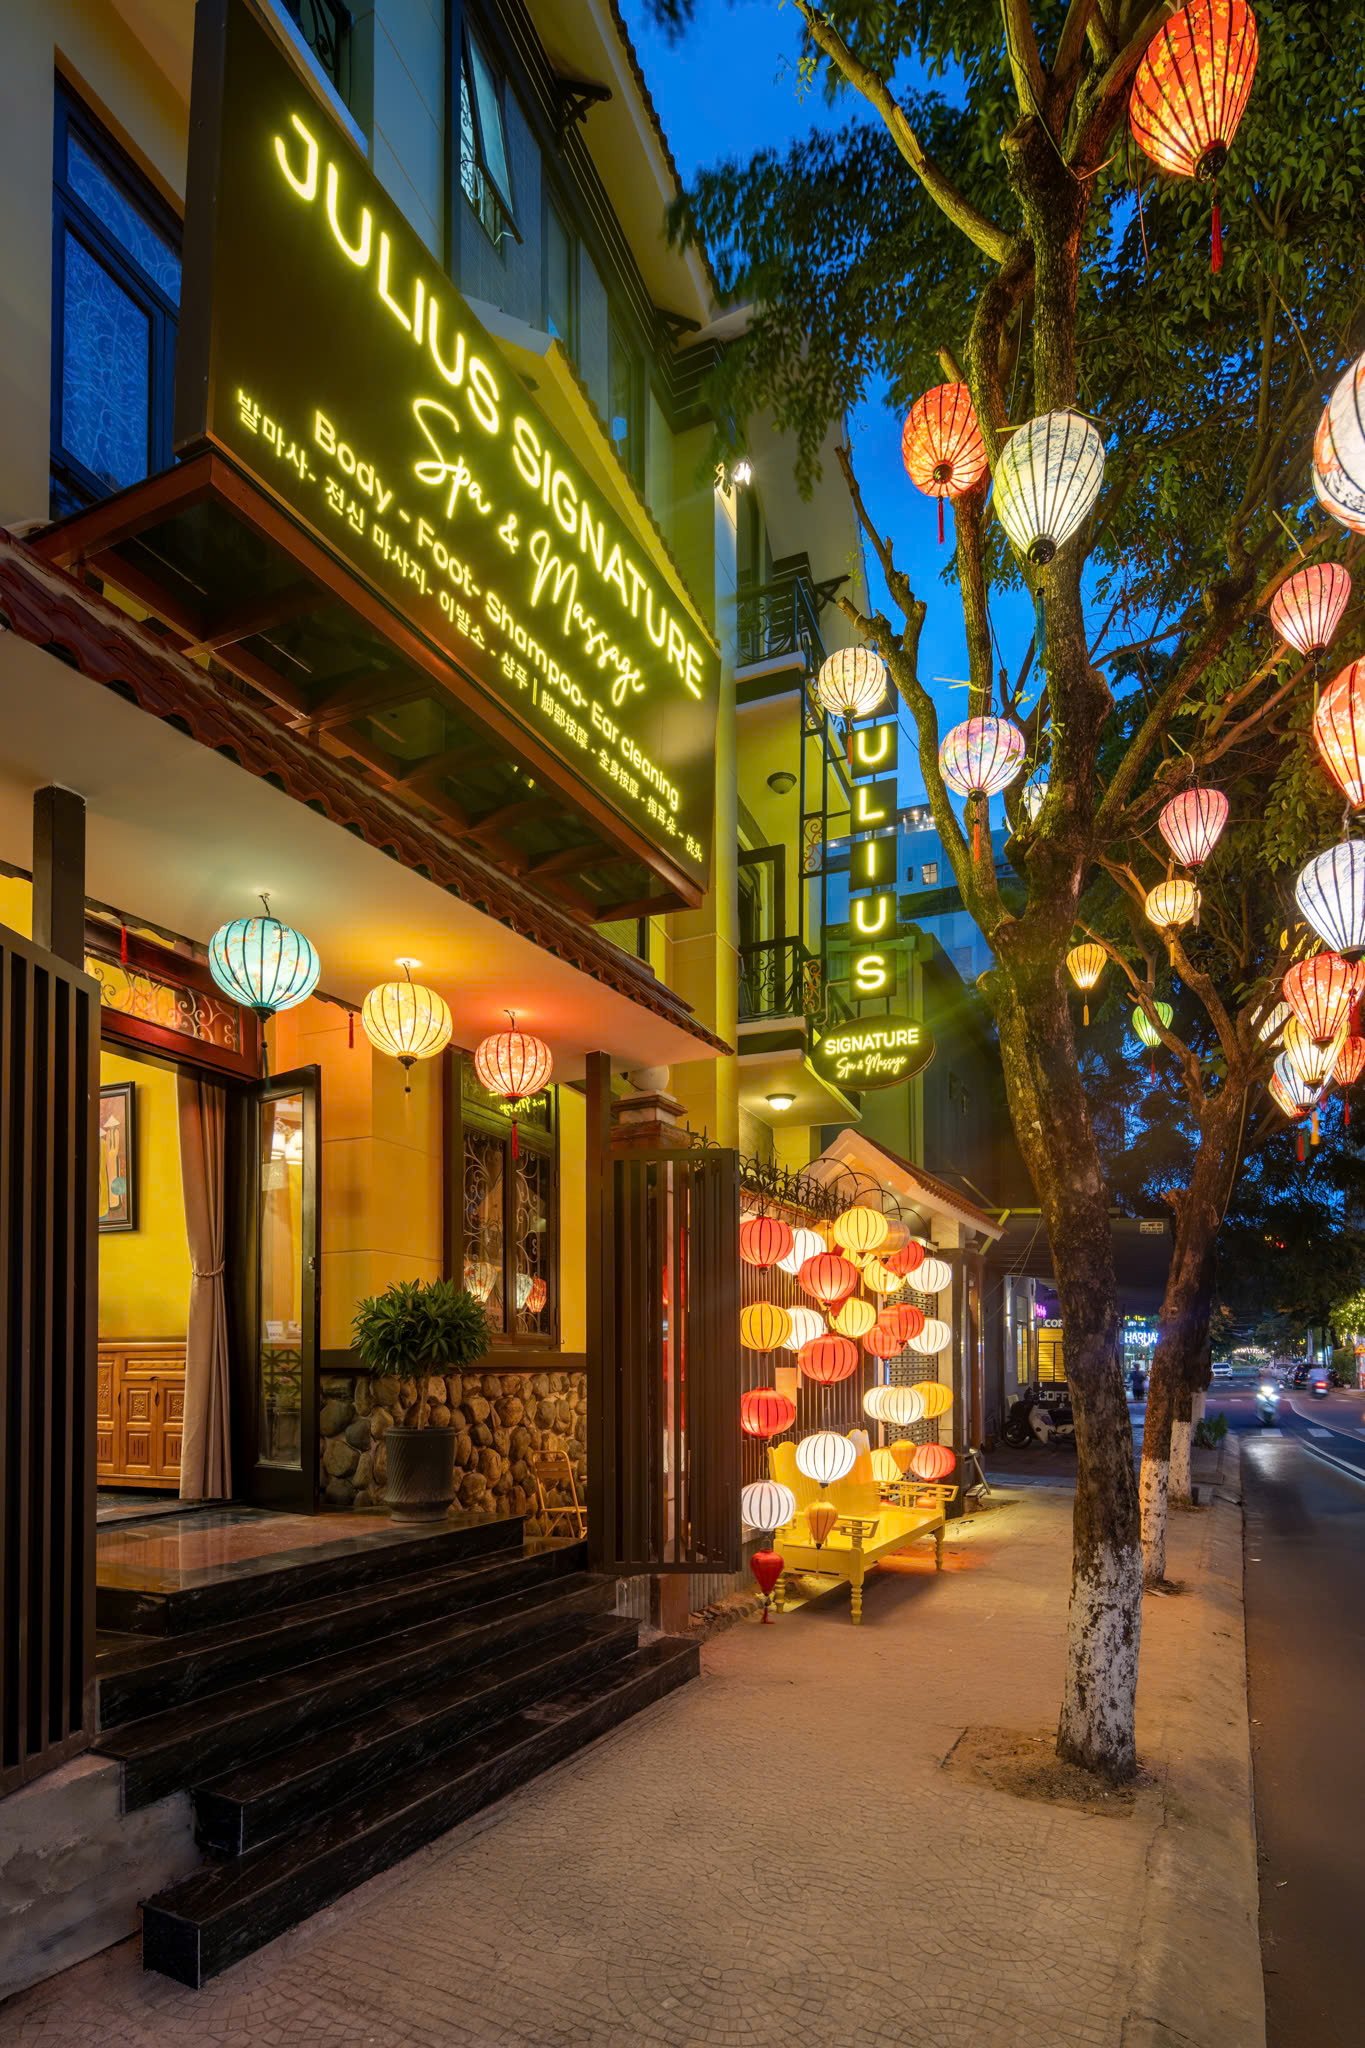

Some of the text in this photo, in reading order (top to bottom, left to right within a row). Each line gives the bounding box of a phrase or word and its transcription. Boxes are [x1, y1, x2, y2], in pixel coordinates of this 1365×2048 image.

[274, 113, 704, 700] JULIUS SIGNATURE
[413, 397, 646, 707] Spa & Massage
[314, 410, 393, 514] Body
[591, 700, 620, 745] Ear
[620, 736, 680, 813] cleaning
[325, 476, 365, 536] 전신
[439, 590, 486, 651] 이발소
[500, 651, 529, 691] 샴푸
[856, 692, 889, 991] ULIUS
[824, 1027, 920, 1056] SIGNATURE
[835, 1056, 856, 1080] Spa
[864, 1052, 907, 1076] Massage
